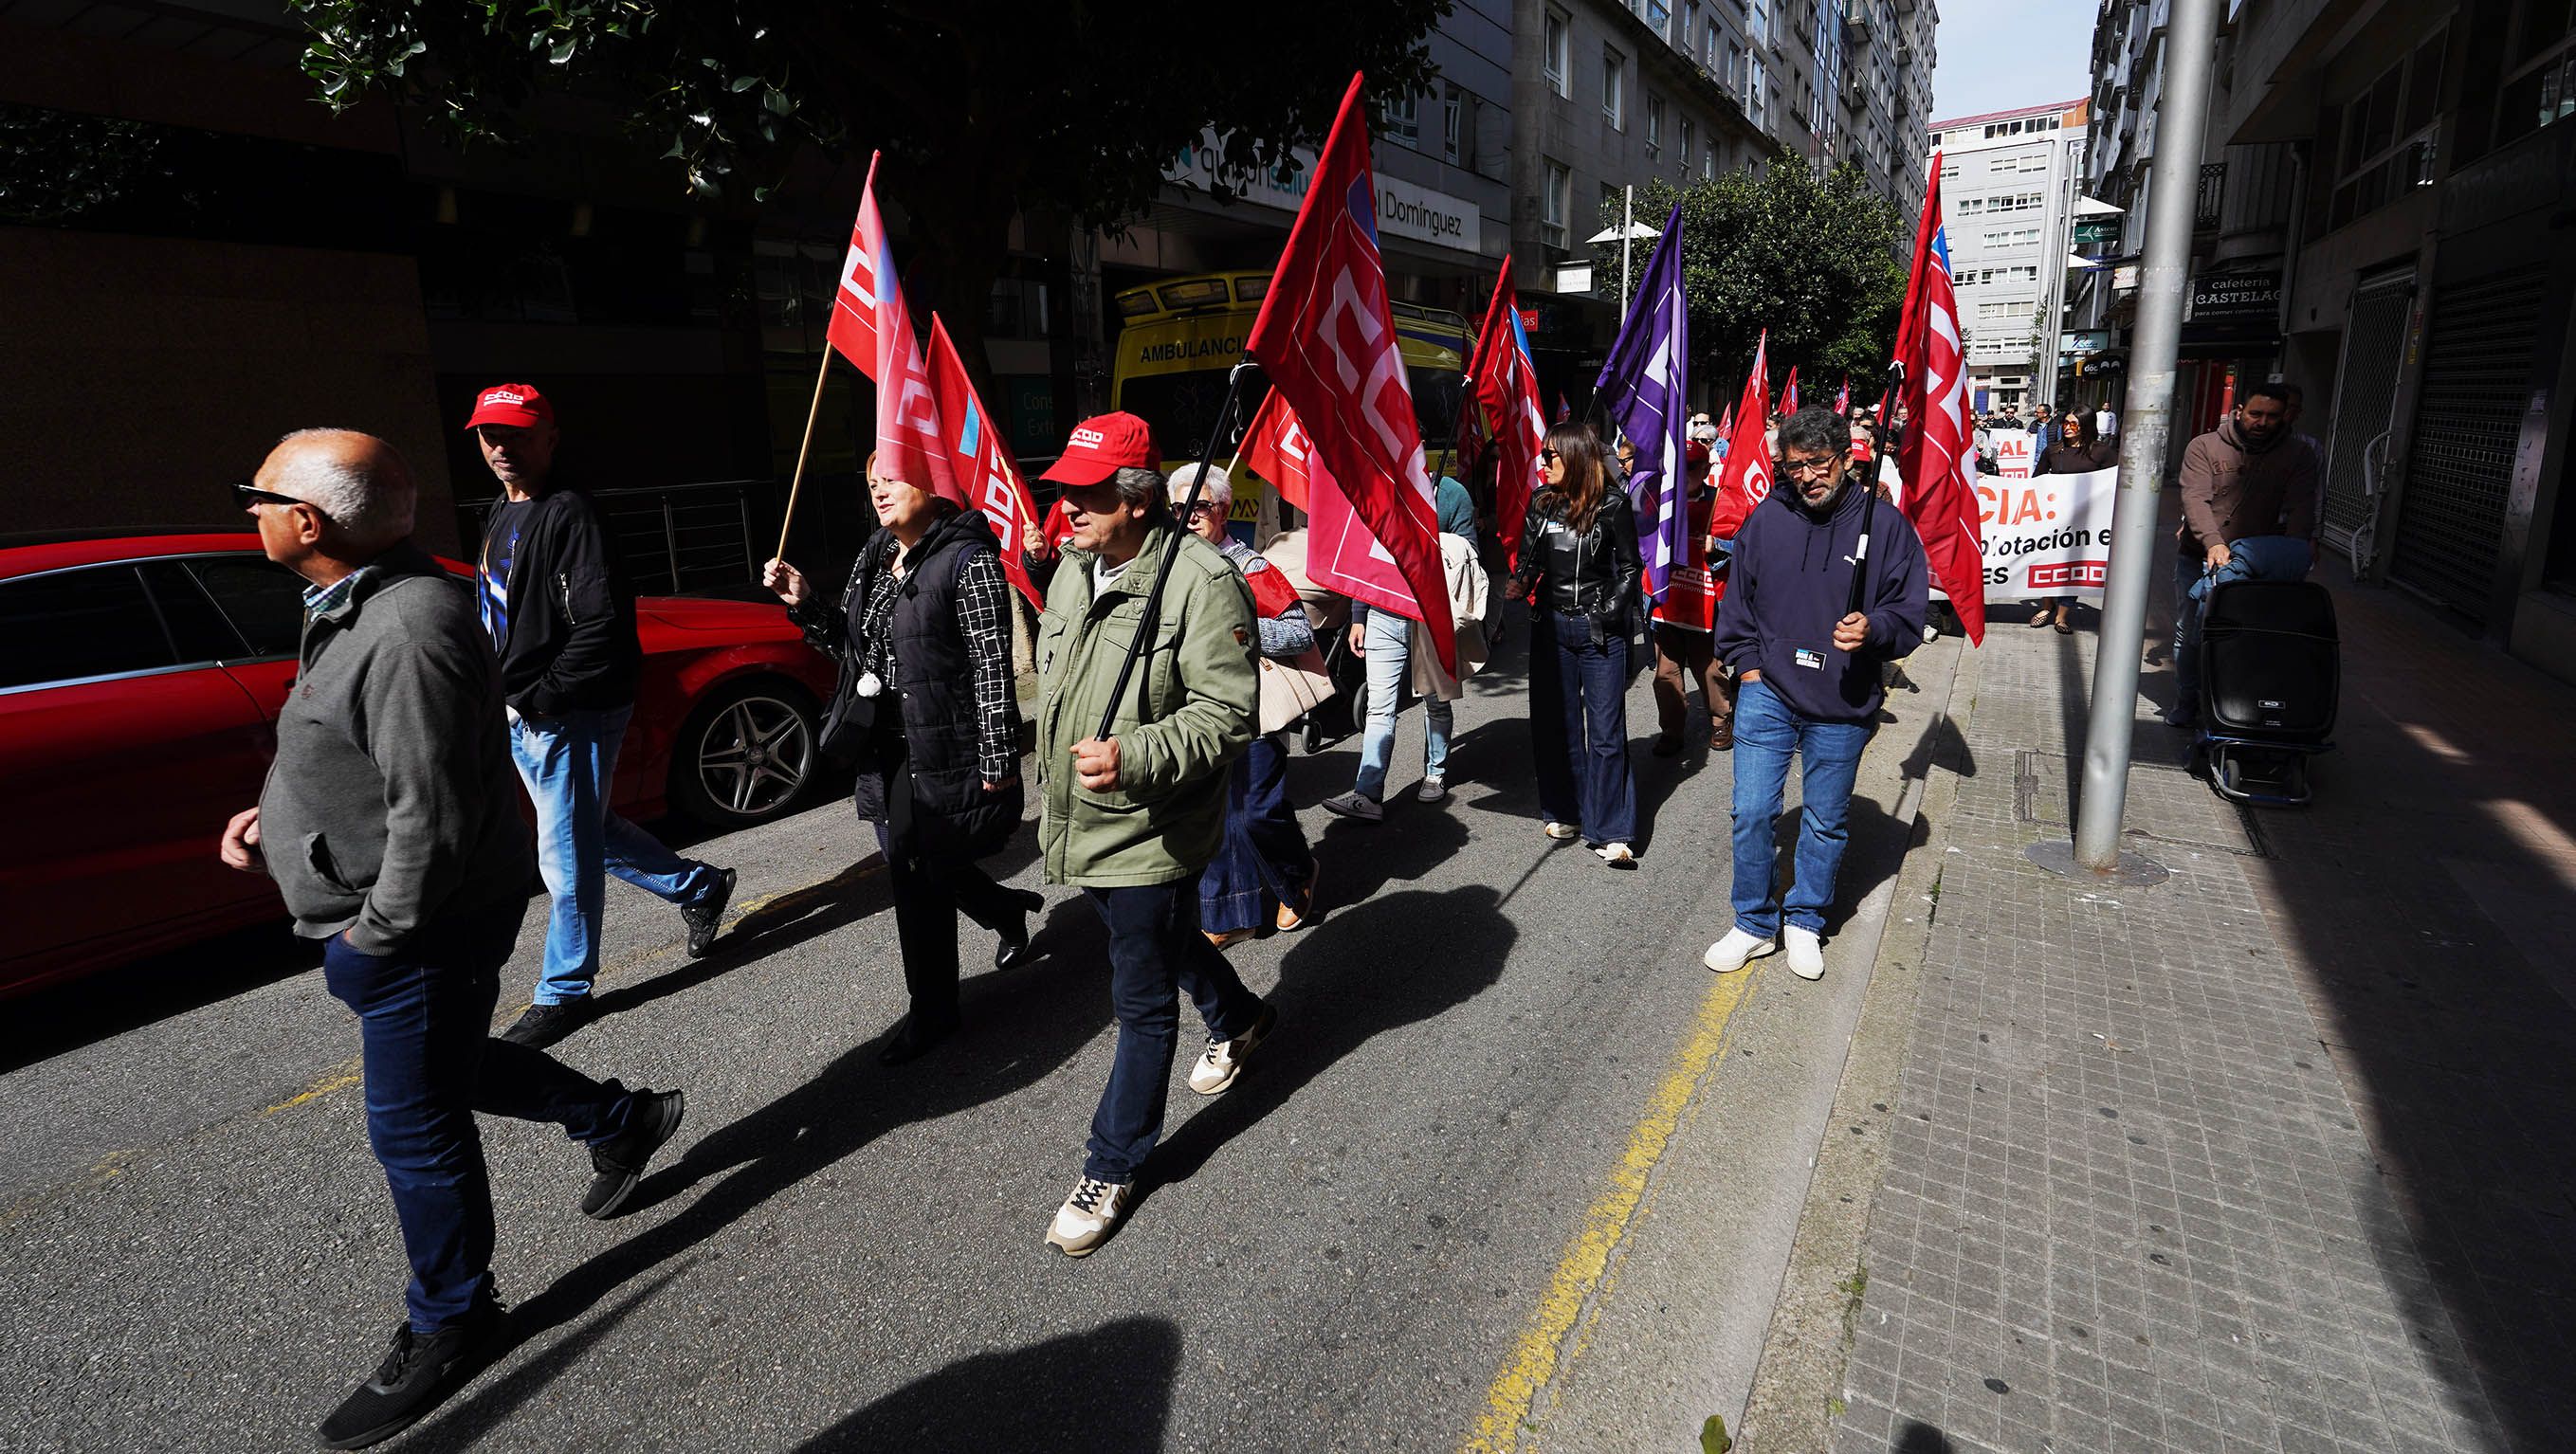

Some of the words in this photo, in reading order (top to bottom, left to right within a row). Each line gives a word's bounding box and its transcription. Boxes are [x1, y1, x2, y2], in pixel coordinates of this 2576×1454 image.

[1386, 191, 1462, 236] Domínguez
[1141, 337, 1248, 363] AMBULANCI
[1978, 486, 2056, 526] CIA:
